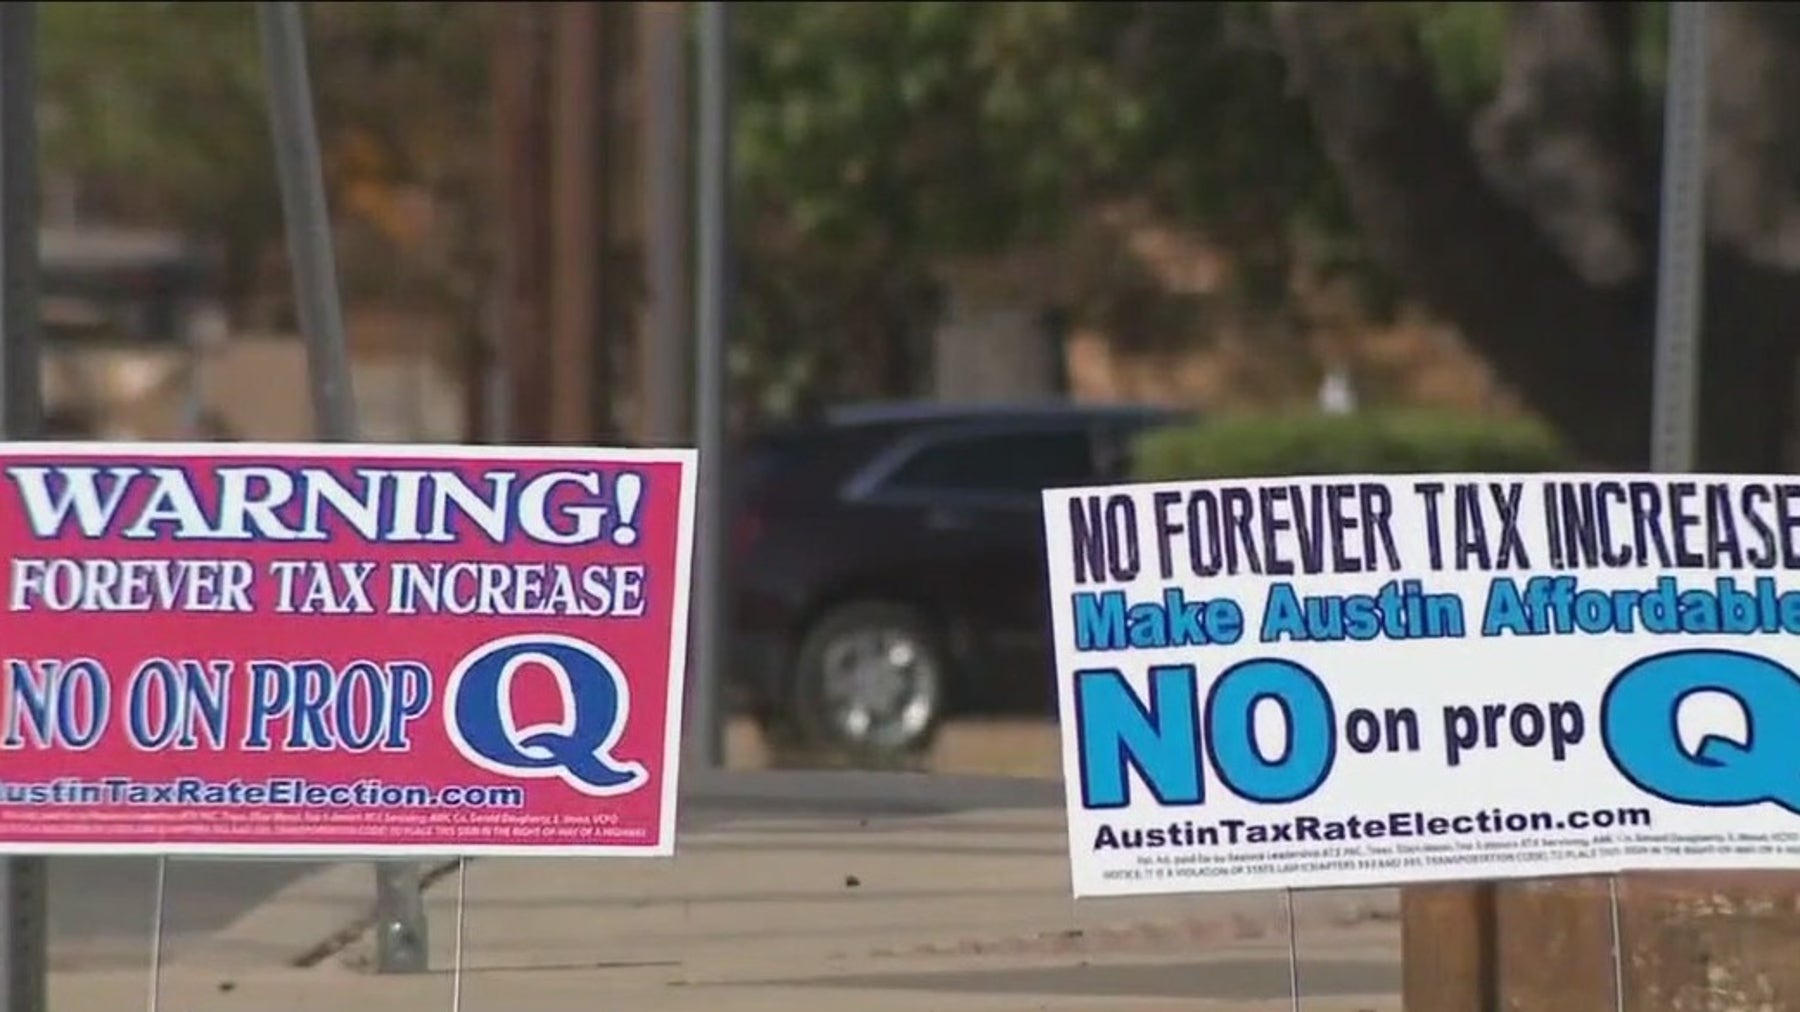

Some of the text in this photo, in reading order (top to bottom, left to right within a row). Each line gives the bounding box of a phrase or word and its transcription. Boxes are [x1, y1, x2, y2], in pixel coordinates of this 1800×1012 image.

[5, 465, 643, 546] WARNING!
[1069, 482, 1800, 583] NO FOREVER TAX INCREASE
[9, 557, 646, 617] FOREVER TAX INCREASE
[1071, 587, 1244, 651] Make
[1259, 578, 1466, 643] Austin
[3, 632, 649, 797] NO ON PROP Q
[1073, 648, 1800, 816] NO on prop Q
[0, 776, 524, 807] ustinTaxRateElection.com
[1093, 807, 1651, 851] AustinTaxRateElection.com
